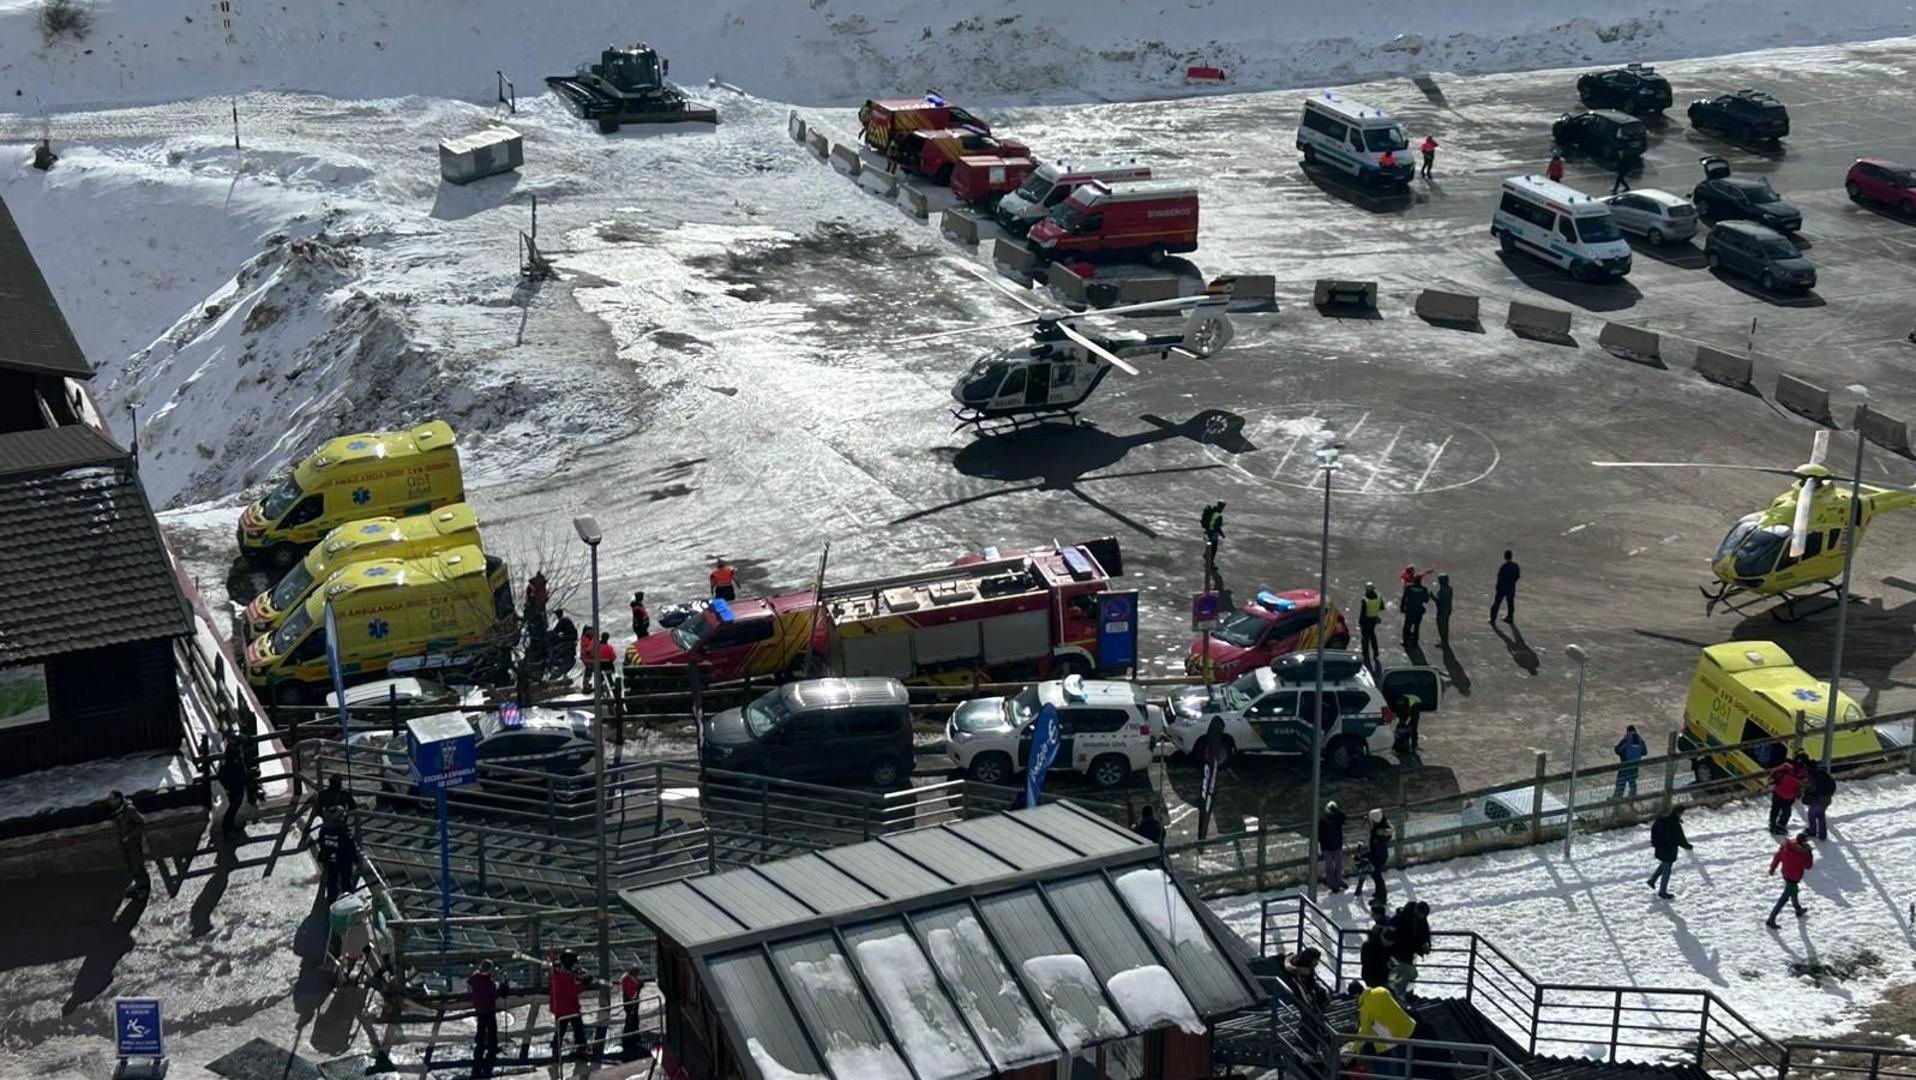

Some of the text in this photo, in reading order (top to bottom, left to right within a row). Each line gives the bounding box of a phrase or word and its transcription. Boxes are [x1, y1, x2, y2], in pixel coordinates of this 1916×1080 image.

[1147, 208, 1191, 218] BOMBEROS
[406, 474, 430, 488] 061
[349, 602, 404, 618] AMBULANCIA
[430, 604, 456, 620] 061
[1713, 697, 1731, 719] 061
